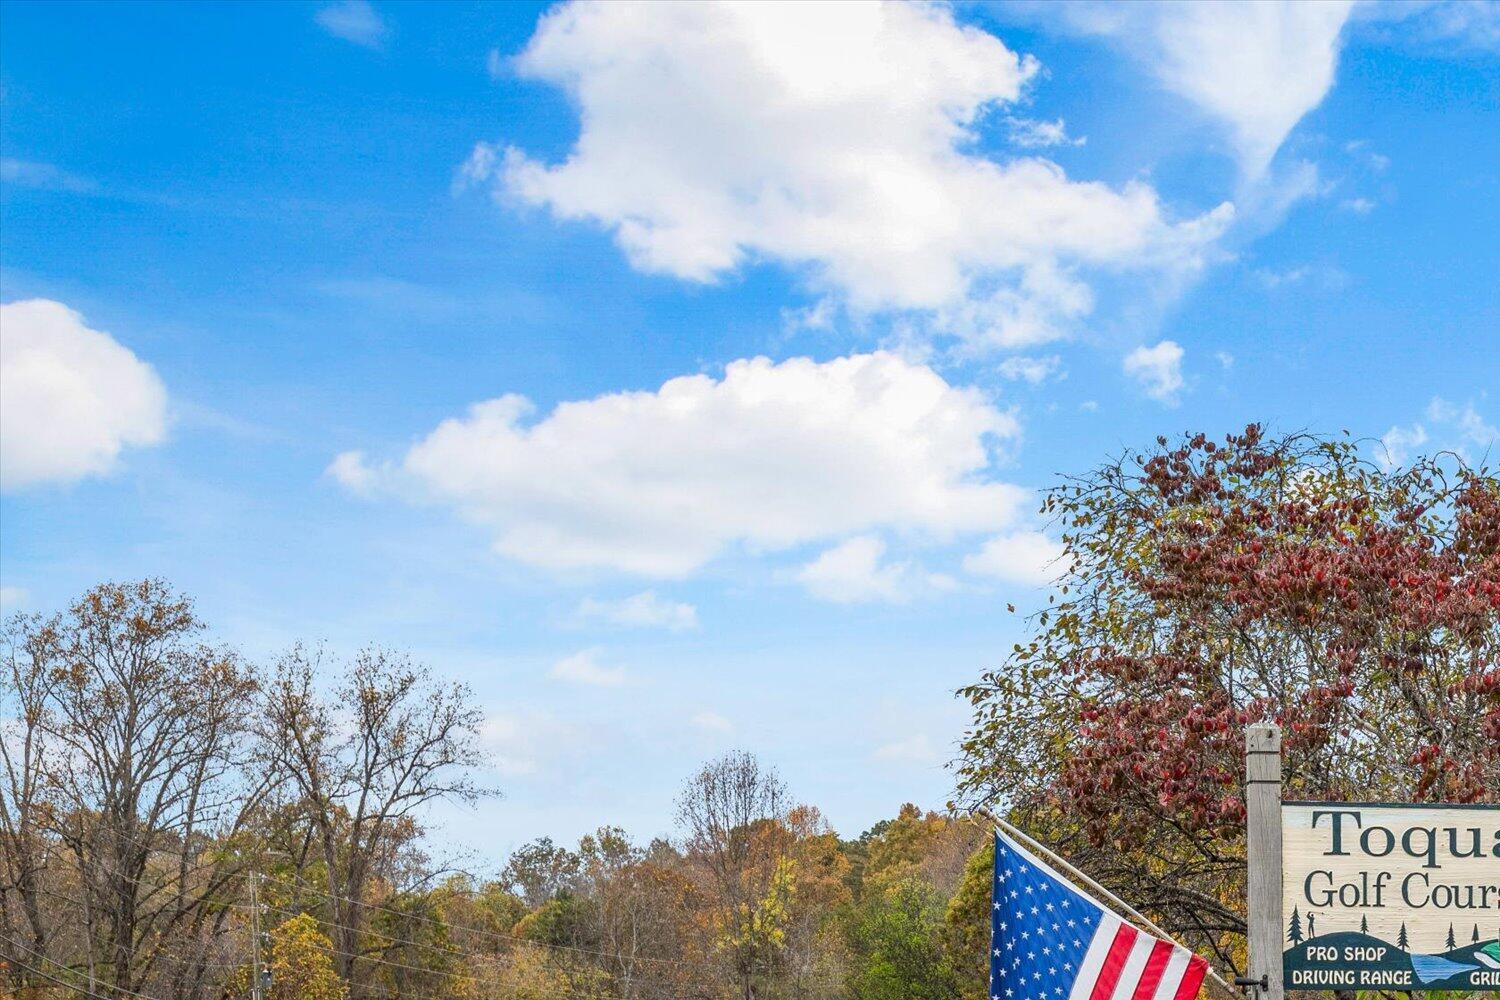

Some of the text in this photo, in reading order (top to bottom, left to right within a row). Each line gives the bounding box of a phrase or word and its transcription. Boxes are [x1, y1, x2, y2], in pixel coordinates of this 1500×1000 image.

[1304, 870, 1391, 908] Golf
[1306, 946, 1387, 961] PRO SHOP
[1293, 970, 1412, 985] DRIVING RANGE
